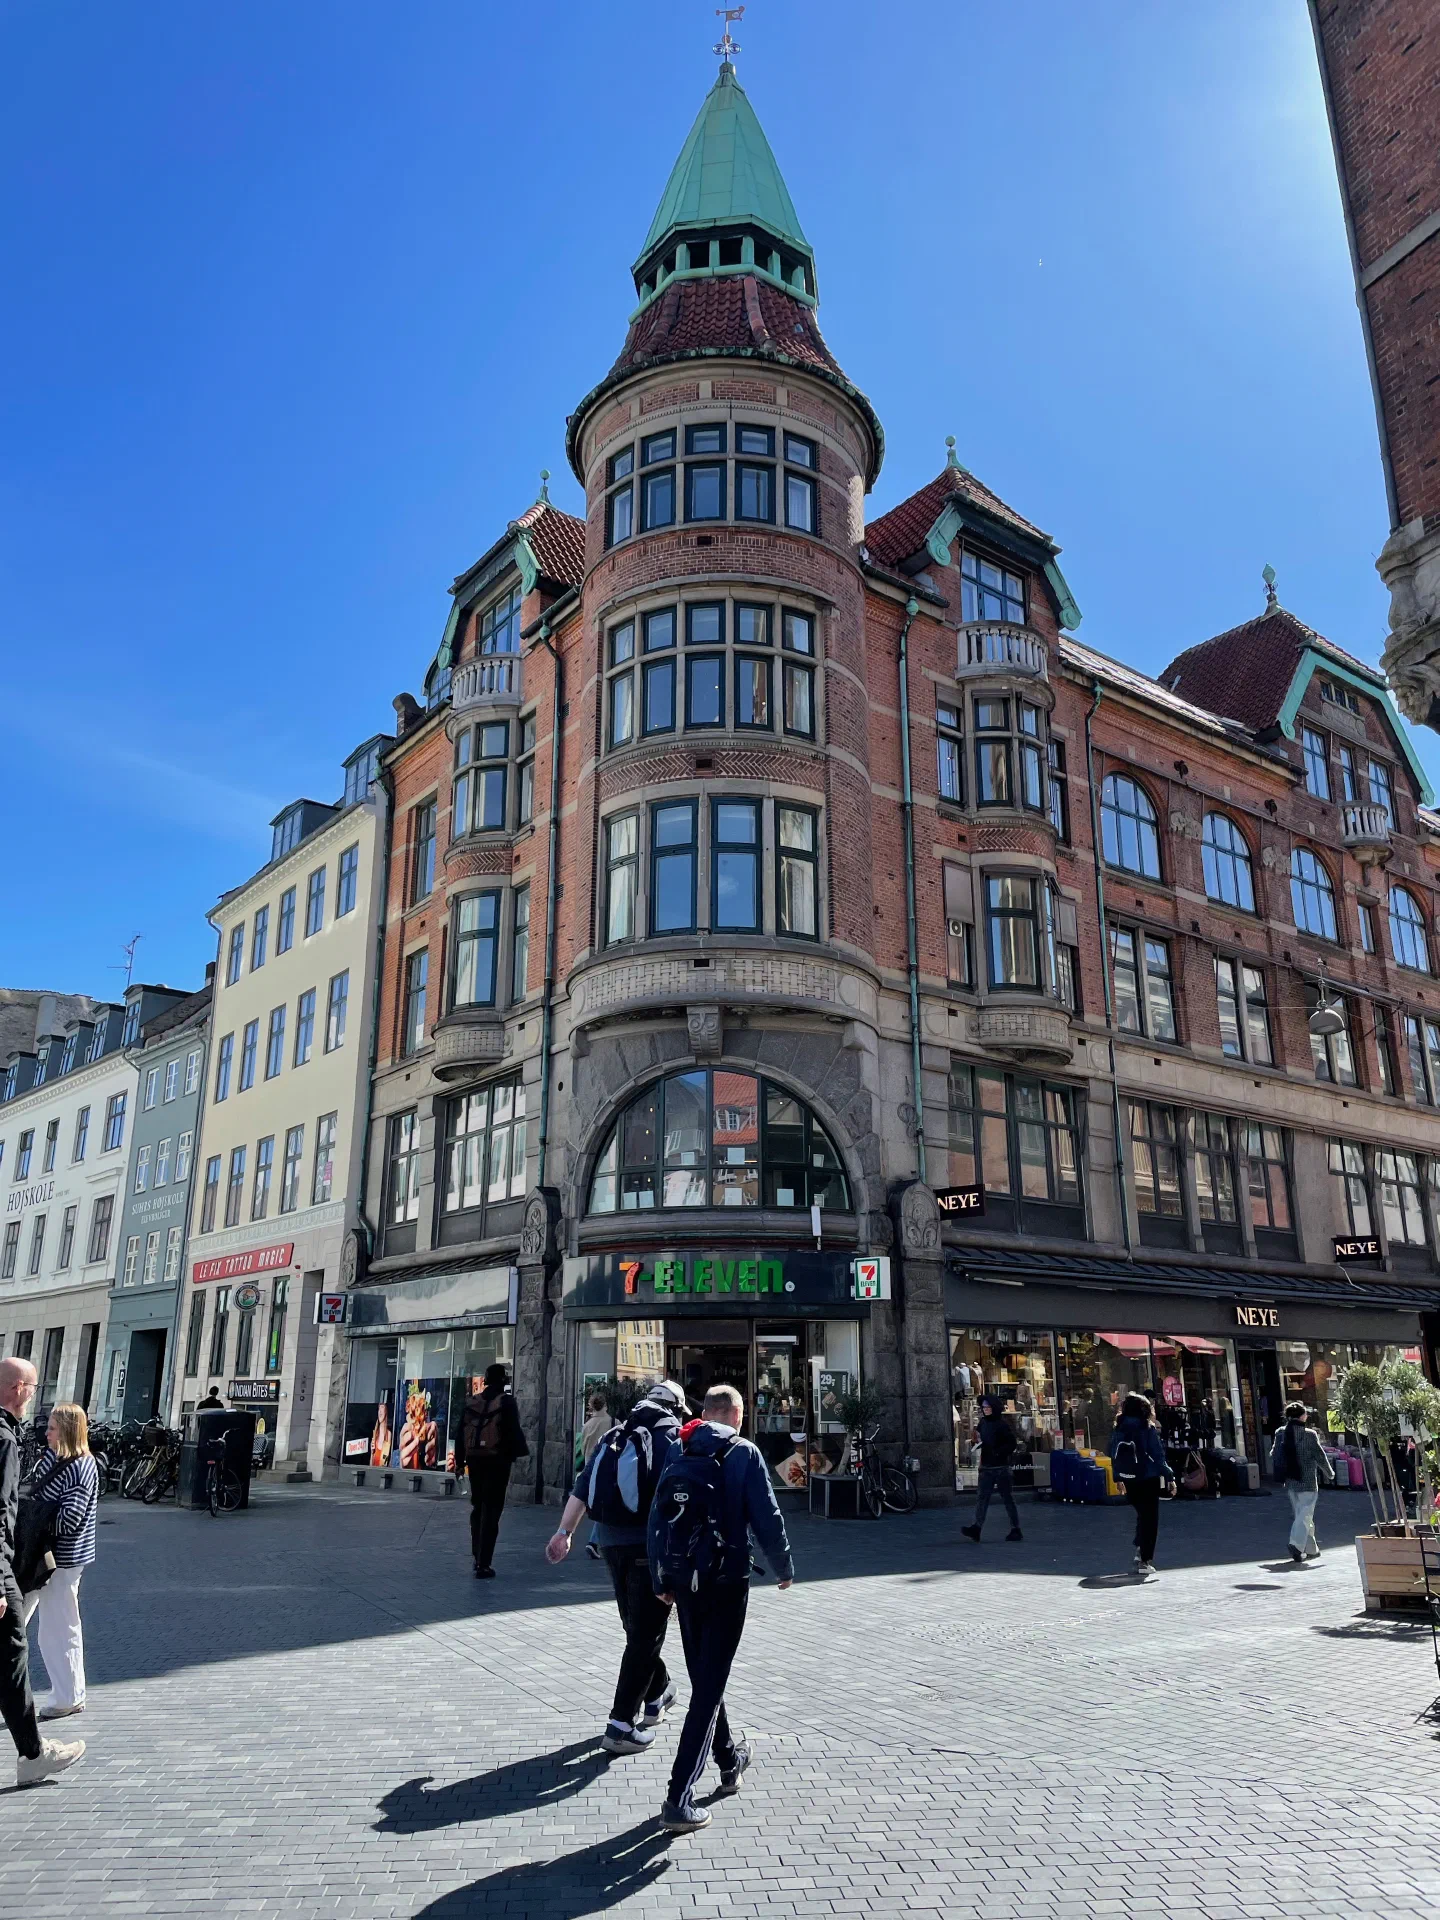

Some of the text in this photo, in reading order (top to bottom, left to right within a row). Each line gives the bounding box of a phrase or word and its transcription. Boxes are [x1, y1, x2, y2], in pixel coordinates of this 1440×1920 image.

[936, 1192, 980, 1210] NEYE
[1335, 1241, 1378, 1256] NEYE
[199, 1247, 285, 1279] LE FIX TATTOO MAGIC
[1236, 1306, 1280, 1327] NEYE
[235, 1382, 268, 1398] INDIAN BITES
